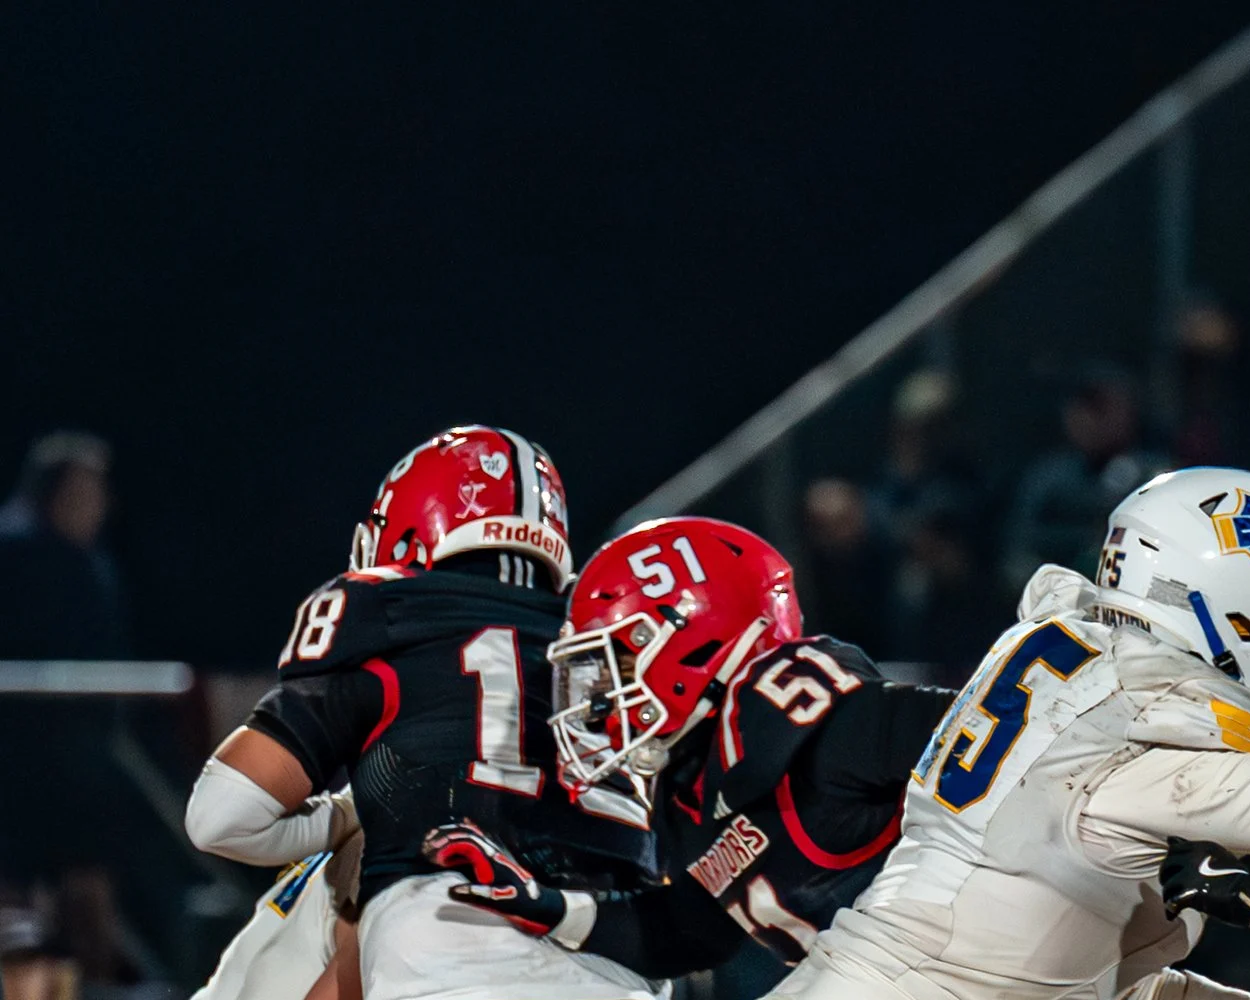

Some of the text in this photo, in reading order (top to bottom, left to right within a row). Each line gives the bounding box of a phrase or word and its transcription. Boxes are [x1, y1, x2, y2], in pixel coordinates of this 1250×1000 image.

[482, 521, 565, 565] Riddell
[627, 536, 707, 599] 51
[753, 645, 864, 726] 51
